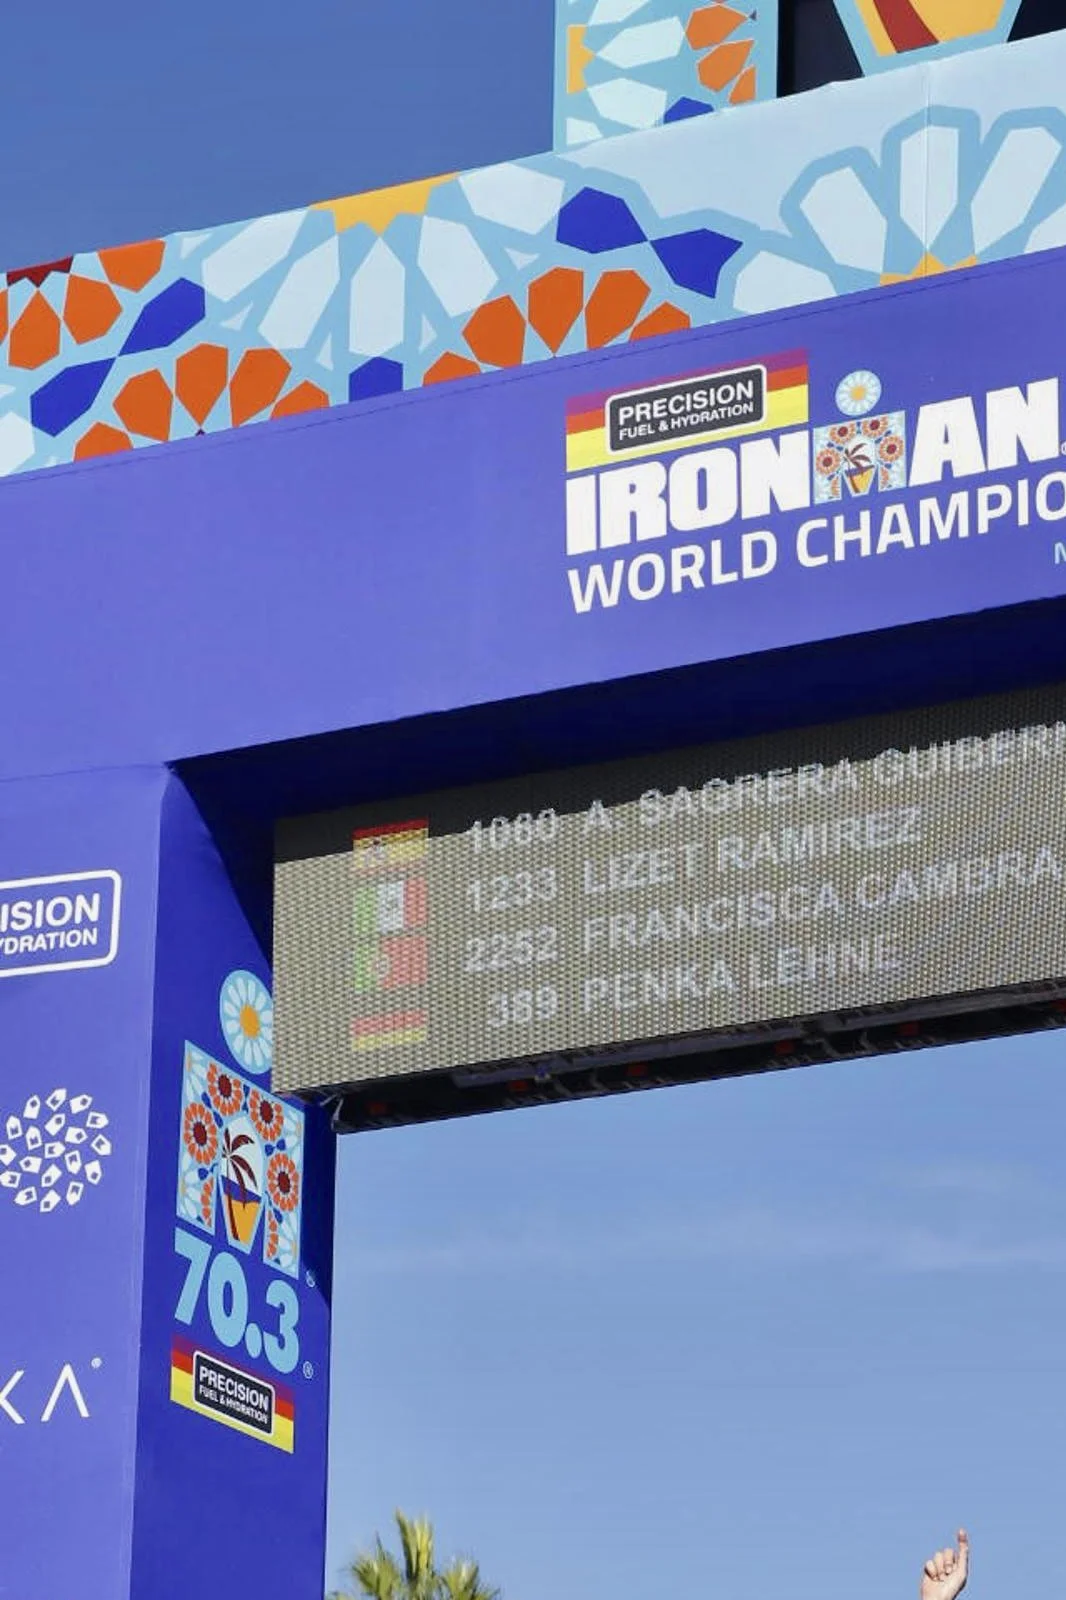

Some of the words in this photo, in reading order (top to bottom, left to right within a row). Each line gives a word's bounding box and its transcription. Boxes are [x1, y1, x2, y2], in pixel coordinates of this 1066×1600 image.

[618, 379, 754, 426] PRECISION
[619, 424, 656, 441] FUEL
[658, 421, 669, 432] &
[670, 402, 754, 430] HYDRATION
[568, 528, 777, 615] WORLD
[466, 867, 559, 913] 1233
[583, 841, 705, 896] LIZET
[716, 806, 925, 873] RAMIREZ
[0, 927, 98, 955] DRATION
[465, 924, 558, 974] 2252
[582, 882, 843, 954] FRANCISCA
[854, 844, 1063, 909] CAMBRA
[485, 983, 560, 1030] 389
[582, 957, 738, 1014] PENKA
[748, 931, 904, 989] LEHNE
[174, 1226, 300, 1375] 70.3
[199, 1365, 270, 1412] PRECISION
[199, 1384, 218, 1402] FUEL
[226, 1396, 269, 1426] HYDRATION
